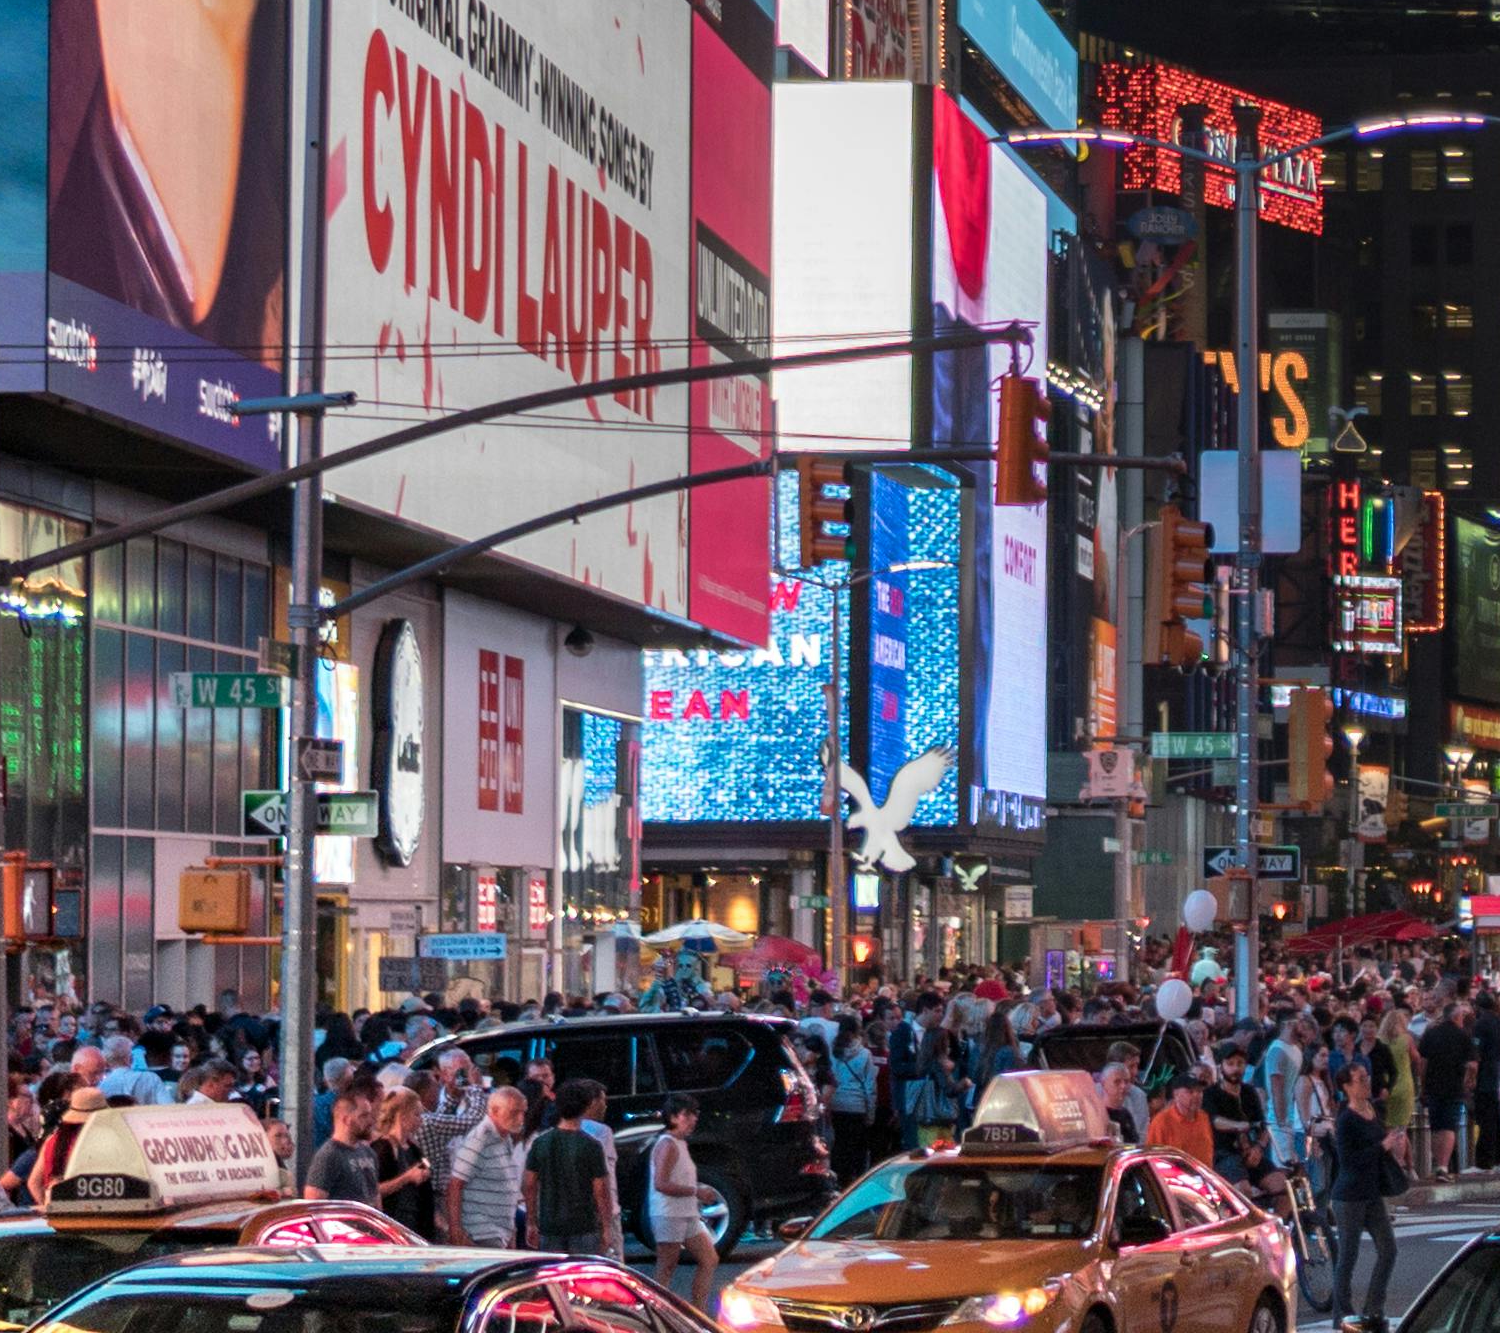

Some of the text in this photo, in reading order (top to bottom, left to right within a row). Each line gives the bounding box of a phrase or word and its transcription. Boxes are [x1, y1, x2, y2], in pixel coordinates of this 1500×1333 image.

[598, 105, 638, 200] SONGS
[639, 138, 655, 211] BY
[362, 27, 657, 423] CYNDI LAUPER
[1004, 533, 1037, 586] COMFORT
[198, 678, 258, 705] W 45
[1172, 741, 1215, 756] W 45
[318, 804, 360, 824] WAY
[1257, 855, 1286, 870] WAY
[237, 1133, 268, 1159] DAY
[982, 1127, 1018, 1141] 7B51
[76, 1176, 126, 1201] 9G80
